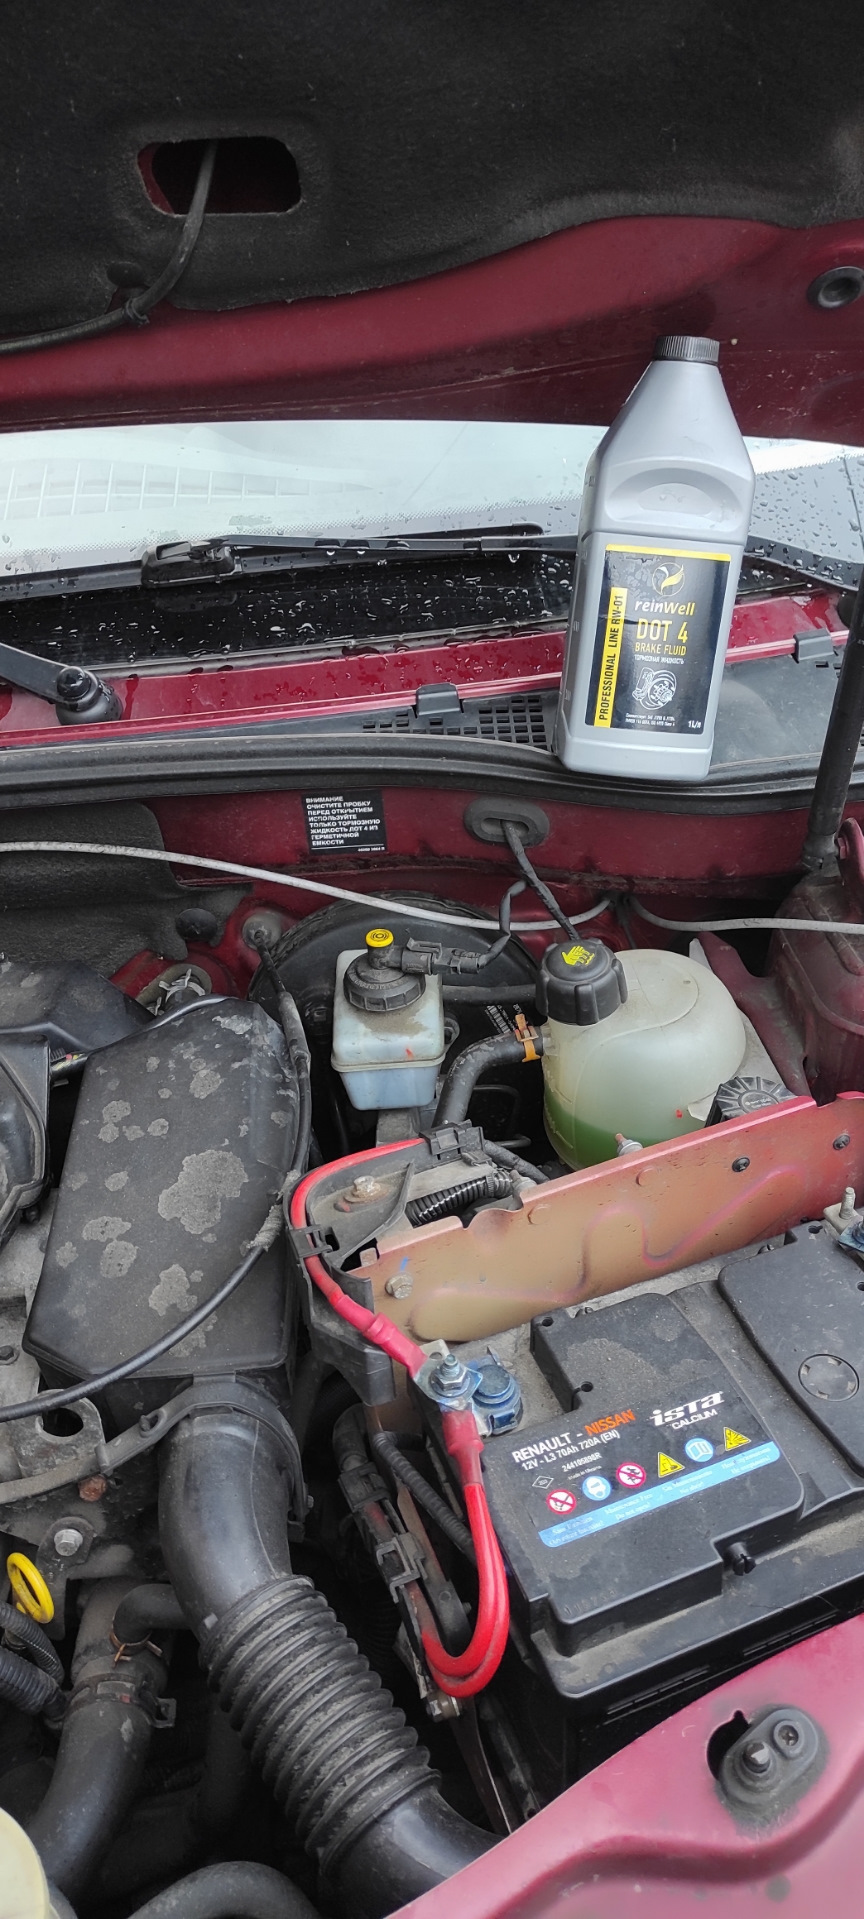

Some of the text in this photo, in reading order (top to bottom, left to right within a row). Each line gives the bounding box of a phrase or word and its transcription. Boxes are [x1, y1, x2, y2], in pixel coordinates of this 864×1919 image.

[634, 599, 696, 616] reinWell
[636, 618, 688, 643] DOT 4
[599, 595, 623, 720] PROFESSIONAL LINE RW-01
[635, 642, 686, 656] BRAKE FLUID
[308, 814, 357, 822] ИСПОЛЬЗУЙТЕ
[311, 832, 359, 840] ГЕРМЕТИЧНОЙ
[672, 1409, 718, 1430] CALCIUM
[512, 1432, 572, 1462] RENAULT
[584, 1409, 636, 1436] NISSAN
[522, 1459, 538, 1470] 12V
[544, 1454, 557, 1463] L3
[557, 1446, 579, 1458] 70Ah
[578, 1438, 600, 1450] 720A
[600, 1430, 620, 1443] (EN)
